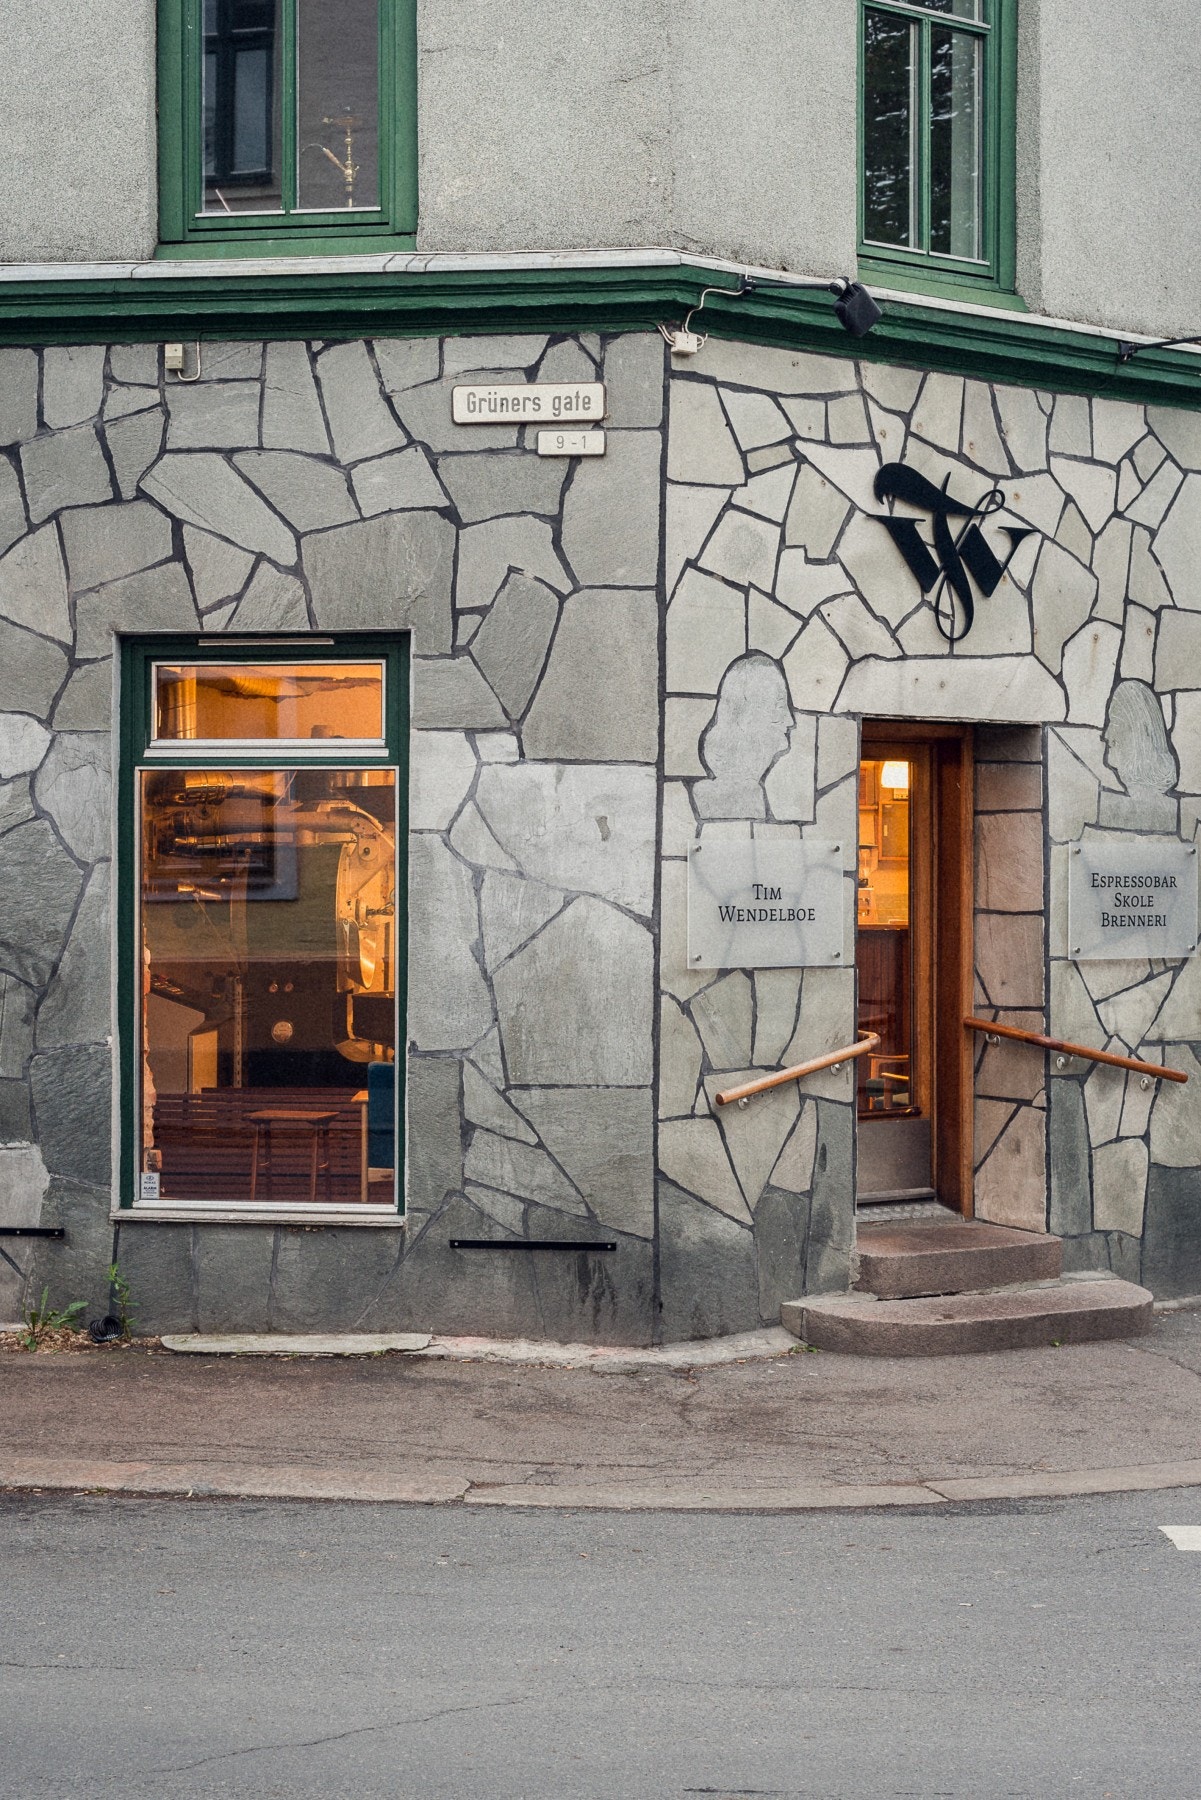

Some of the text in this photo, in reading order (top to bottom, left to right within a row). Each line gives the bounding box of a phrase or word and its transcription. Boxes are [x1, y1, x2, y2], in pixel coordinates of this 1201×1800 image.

[466, 390, 592, 417] Grüners gate
[1091, 872, 1177, 888] ESPRESSOBAR
[752, 883, 782, 901] TIM
[1114, 892, 1154, 908] SKOLE
[718, 905, 816, 922] WENDELBOE
[1101, 911, 1167, 927] BRENNERI
